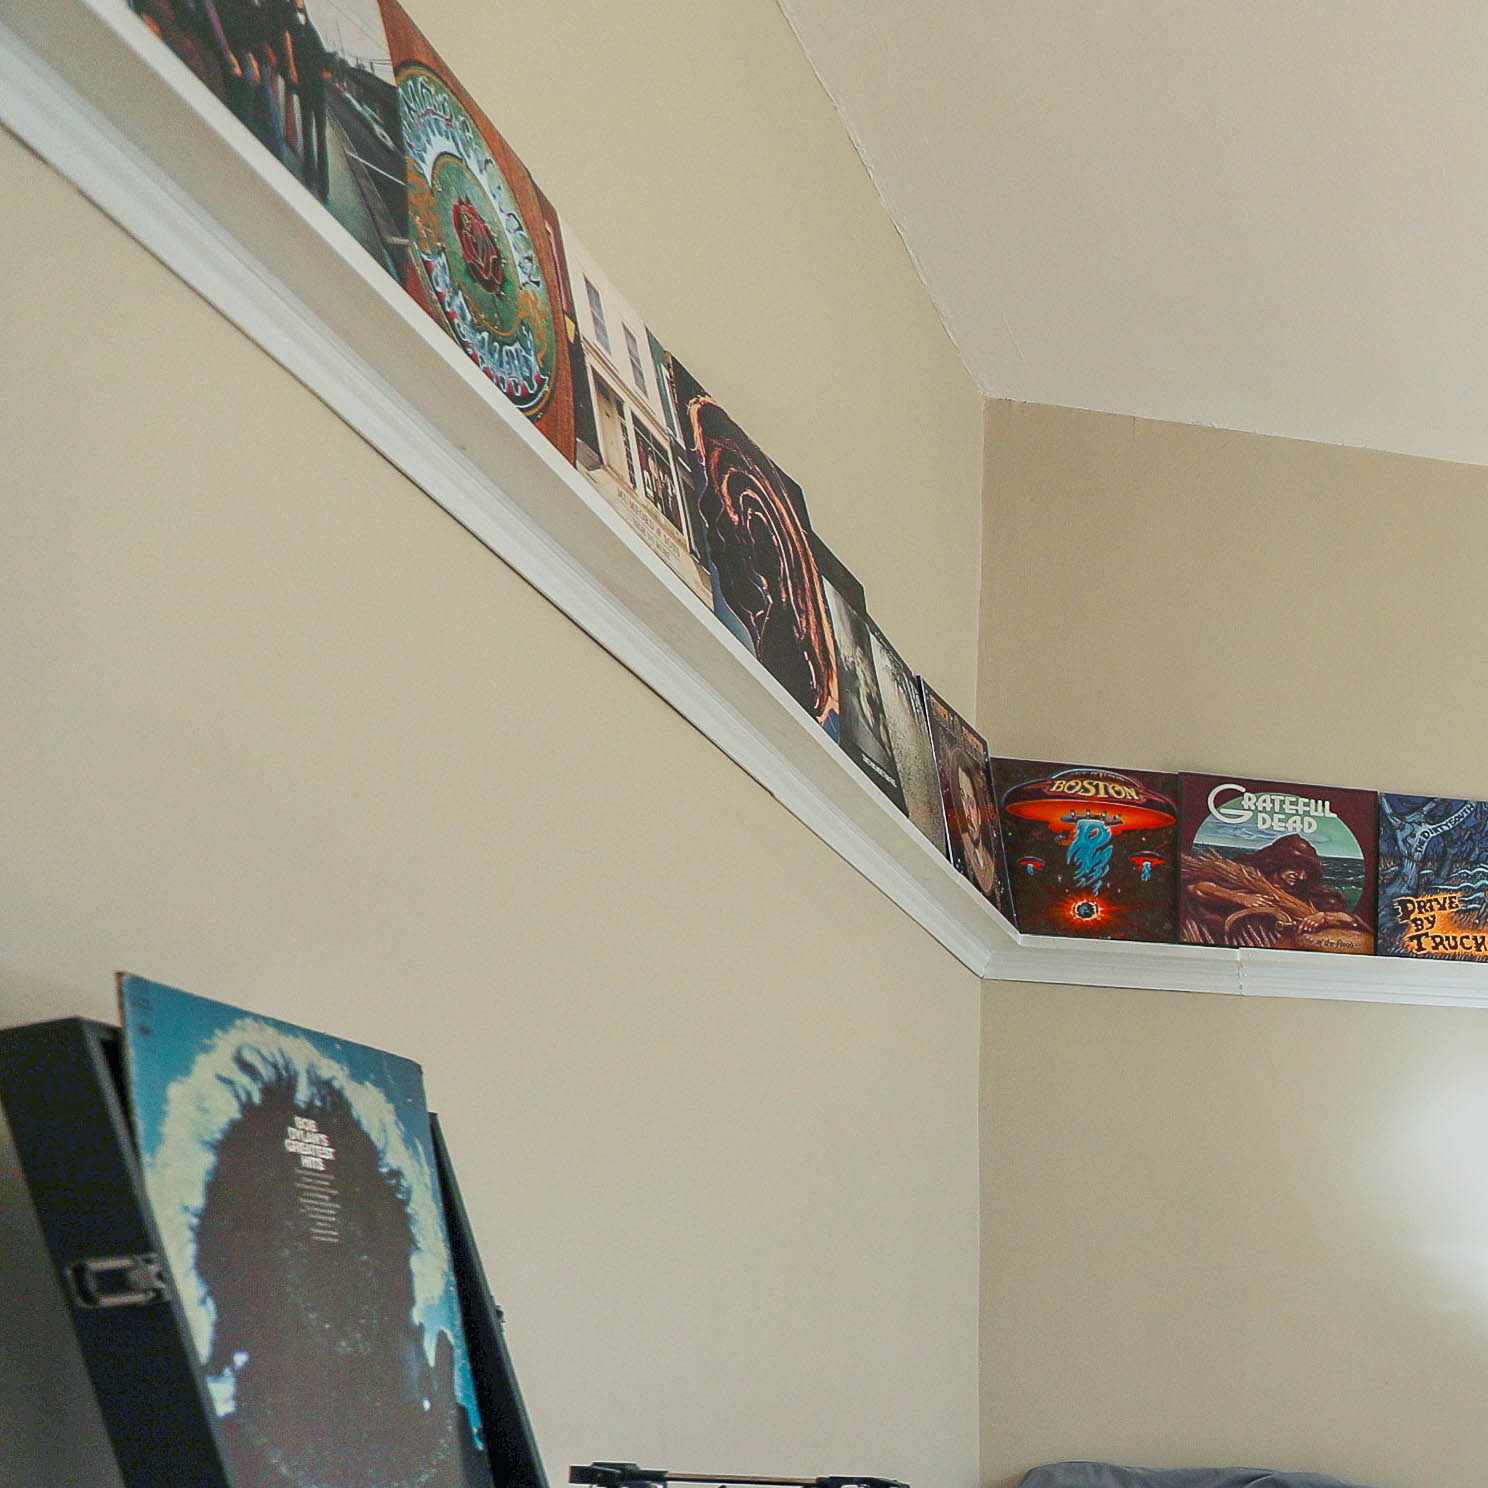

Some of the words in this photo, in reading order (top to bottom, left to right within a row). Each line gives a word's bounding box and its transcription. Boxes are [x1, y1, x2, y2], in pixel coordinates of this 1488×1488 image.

[1051, 779, 1139, 800] BOSTON
[1208, 783, 1338, 824] GRATEFUL
[1257, 812, 1318, 833] DEAD
[1396, 894, 1461, 921] DRIVE
[1410, 914, 1437, 933] BY
[294, 1116, 319, 1132] BOB
[284, 1139, 337, 1160] GREATEST
[300, 1155, 326, 1171] HITS
